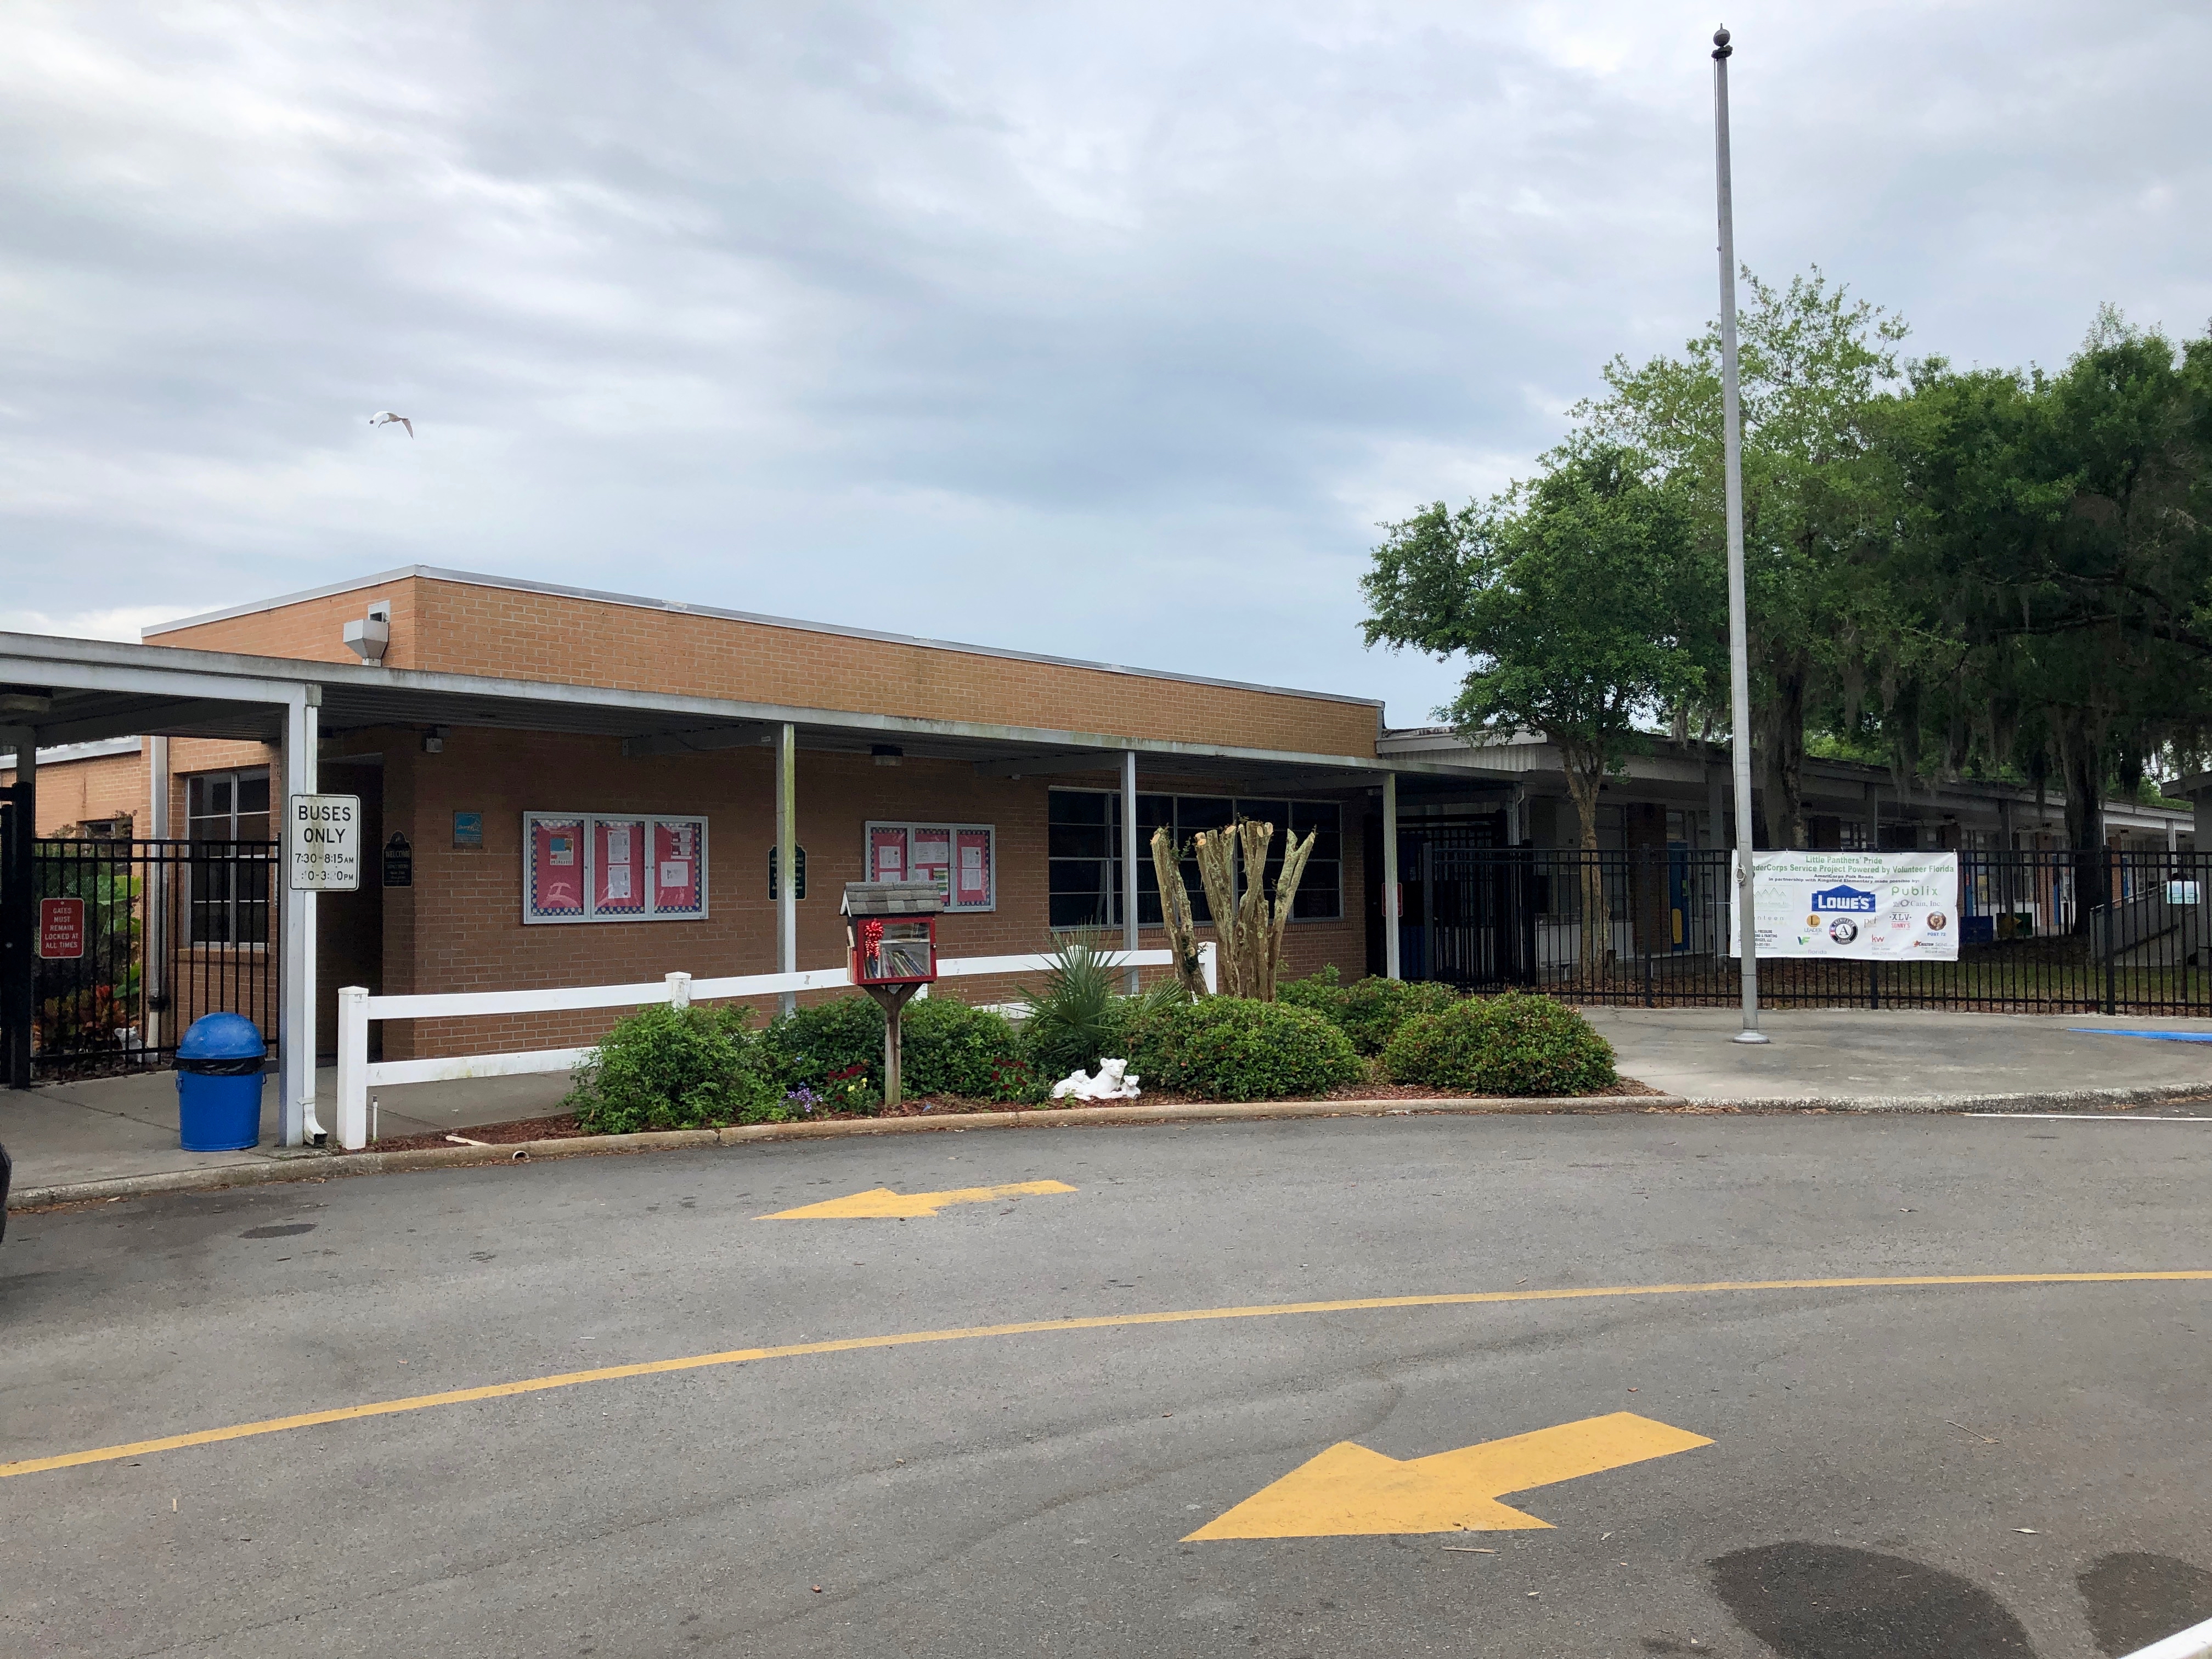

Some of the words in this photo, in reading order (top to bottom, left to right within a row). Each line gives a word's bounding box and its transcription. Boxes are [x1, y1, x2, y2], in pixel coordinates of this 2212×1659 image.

[298, 805, 351, 821] BUSES
[303, 828, 346, 843] ONLY
[1752, 864, 1788, 872] aderCorps
[1819, 865, 1846, 873] Project
[1882, 866, 1891, 874] by
[1892, 886, 1938, 896] Publix
[1818, 895, 1870, 910] LOWE'S
[1810, 916, 1818, 926] L
[1839, 925, 1849, 935] A
[1871, 934, 1885, 943] kw
